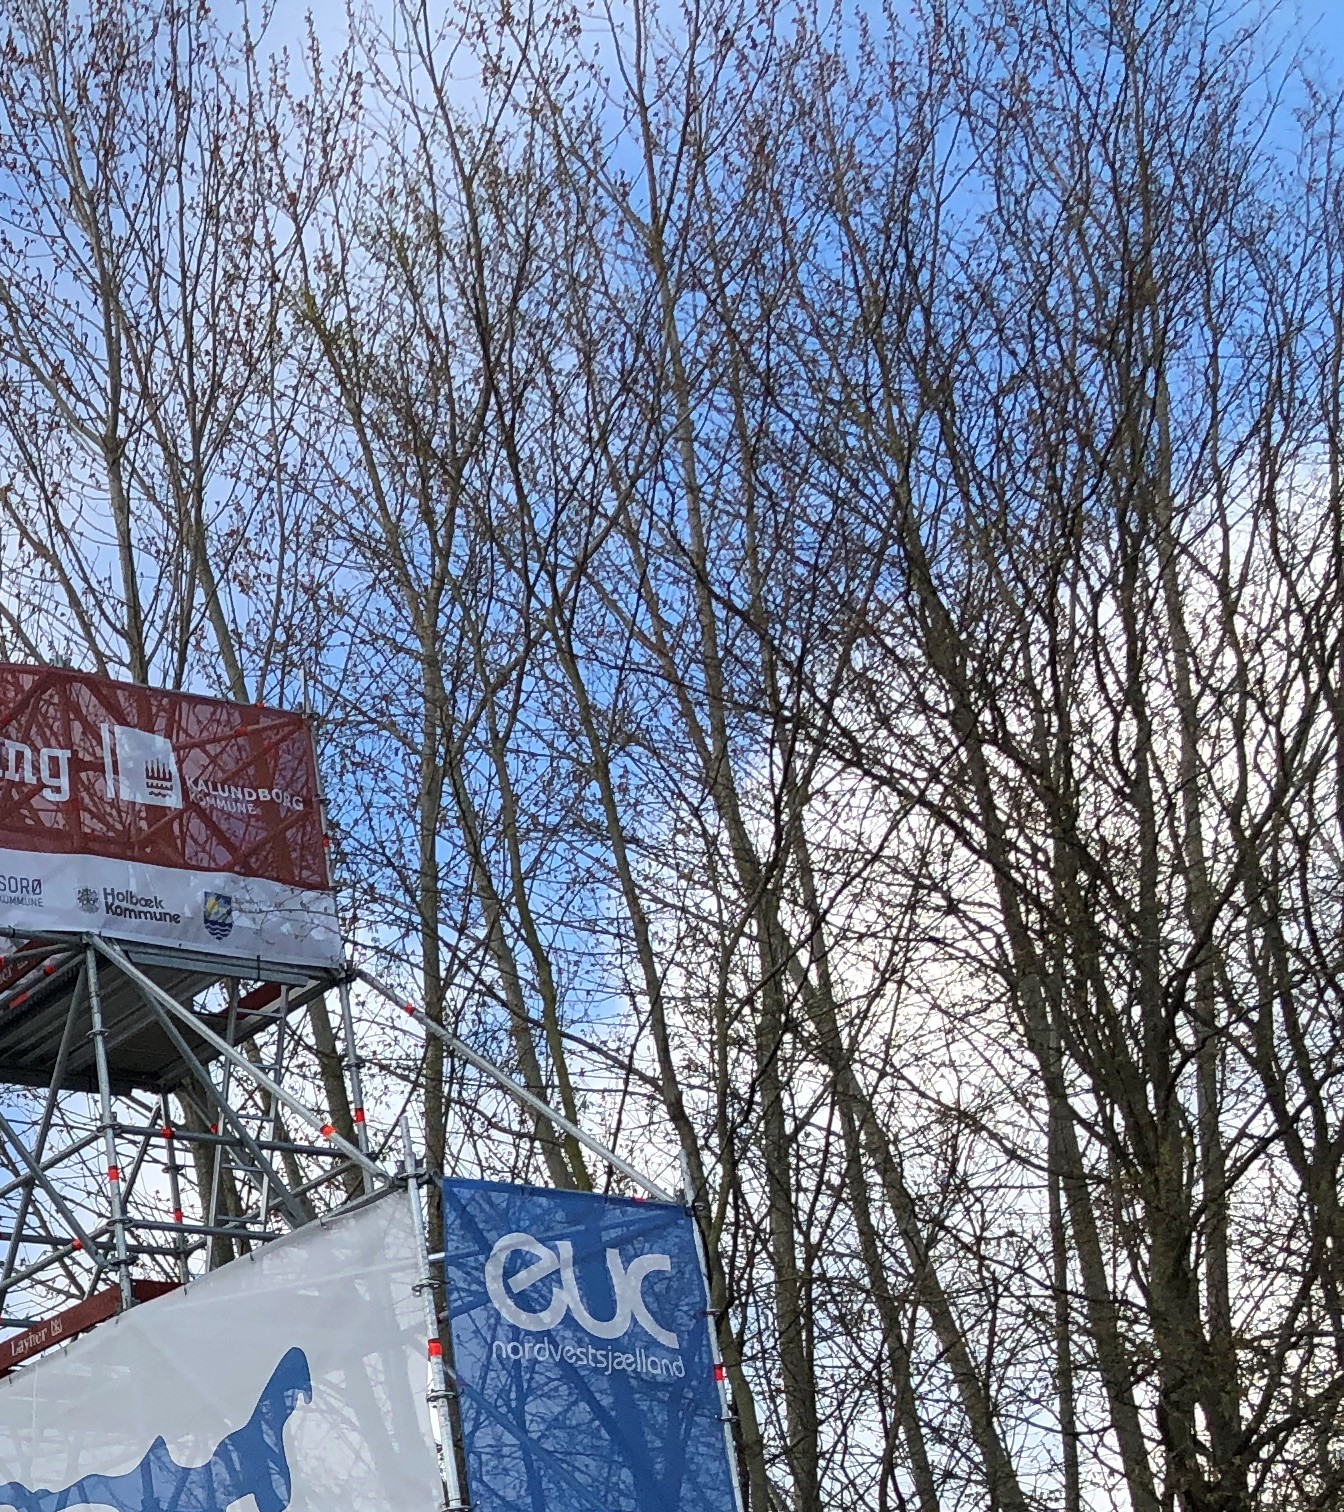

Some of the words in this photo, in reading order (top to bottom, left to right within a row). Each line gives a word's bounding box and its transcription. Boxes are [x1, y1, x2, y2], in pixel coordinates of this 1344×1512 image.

[184, 774, 304, 811] KALUNDBORG
[188, 791, 258, 815] KOMMUNE
[102, 886, 165, 910] Holbæk
[104, 900, 182, 925] Kommune
[484, 1232, 680, 1350] euc
[11, 1324, 48, 1358] Layher
[491, 1336, 687, 1379] nordvestsjælland
